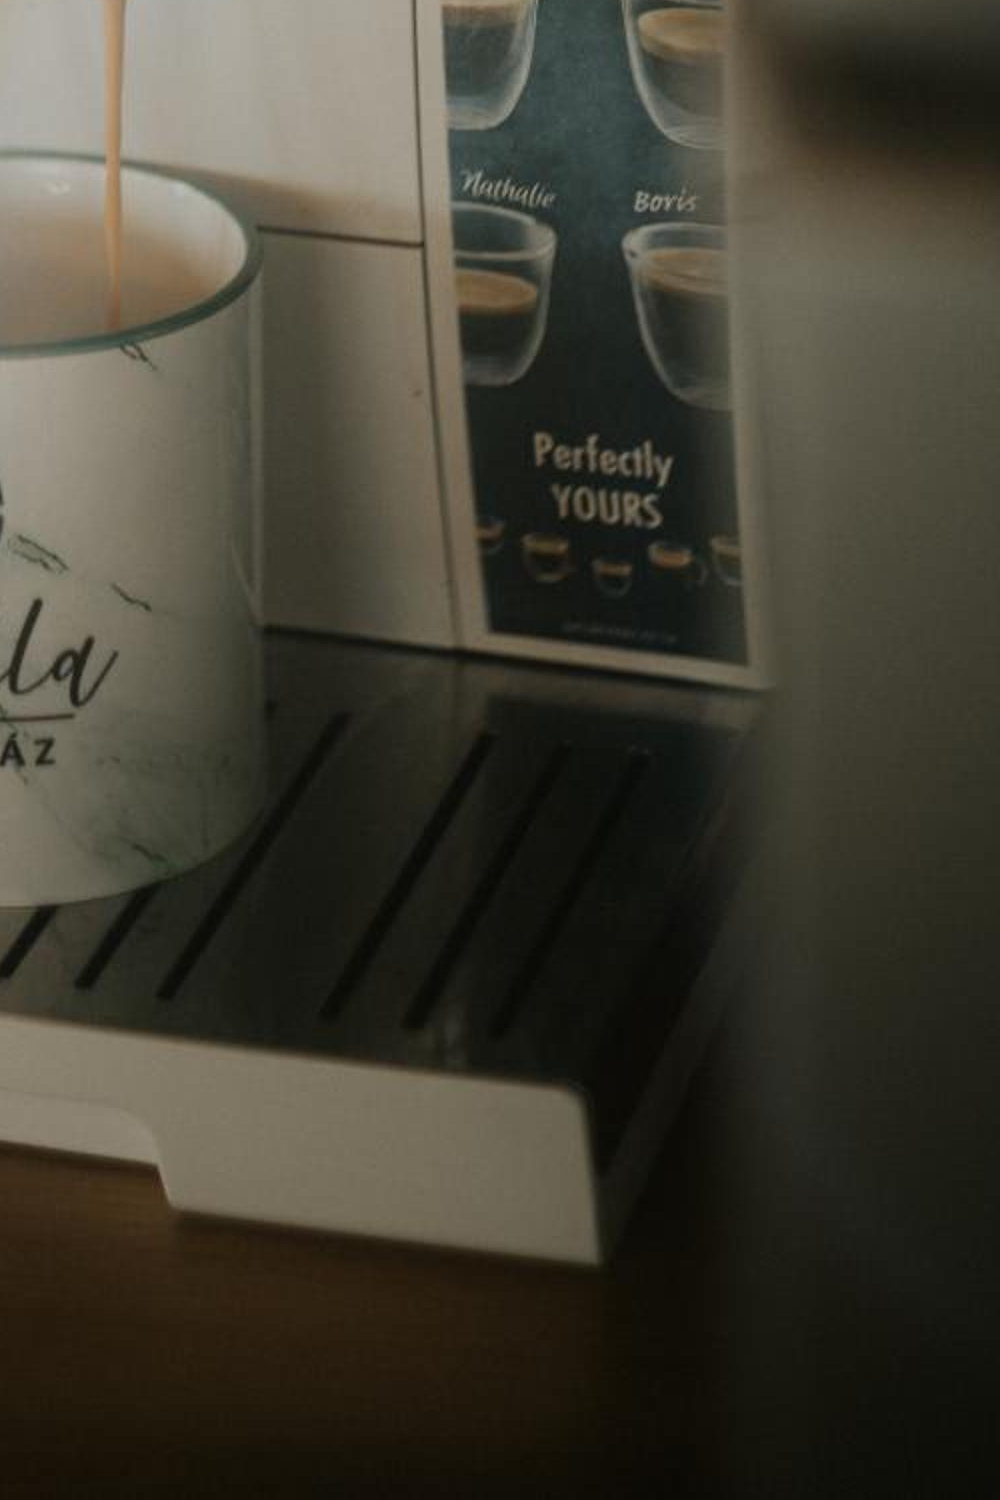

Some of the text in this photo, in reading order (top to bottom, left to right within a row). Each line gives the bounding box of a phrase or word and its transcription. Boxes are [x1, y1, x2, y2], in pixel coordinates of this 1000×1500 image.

[459, 167, 557, 210] Nathalie
[633, 186, 698, 213] Boris
[533, 430, 675, 488] Perfectly
[551, 483, 664, 530] YOURS
